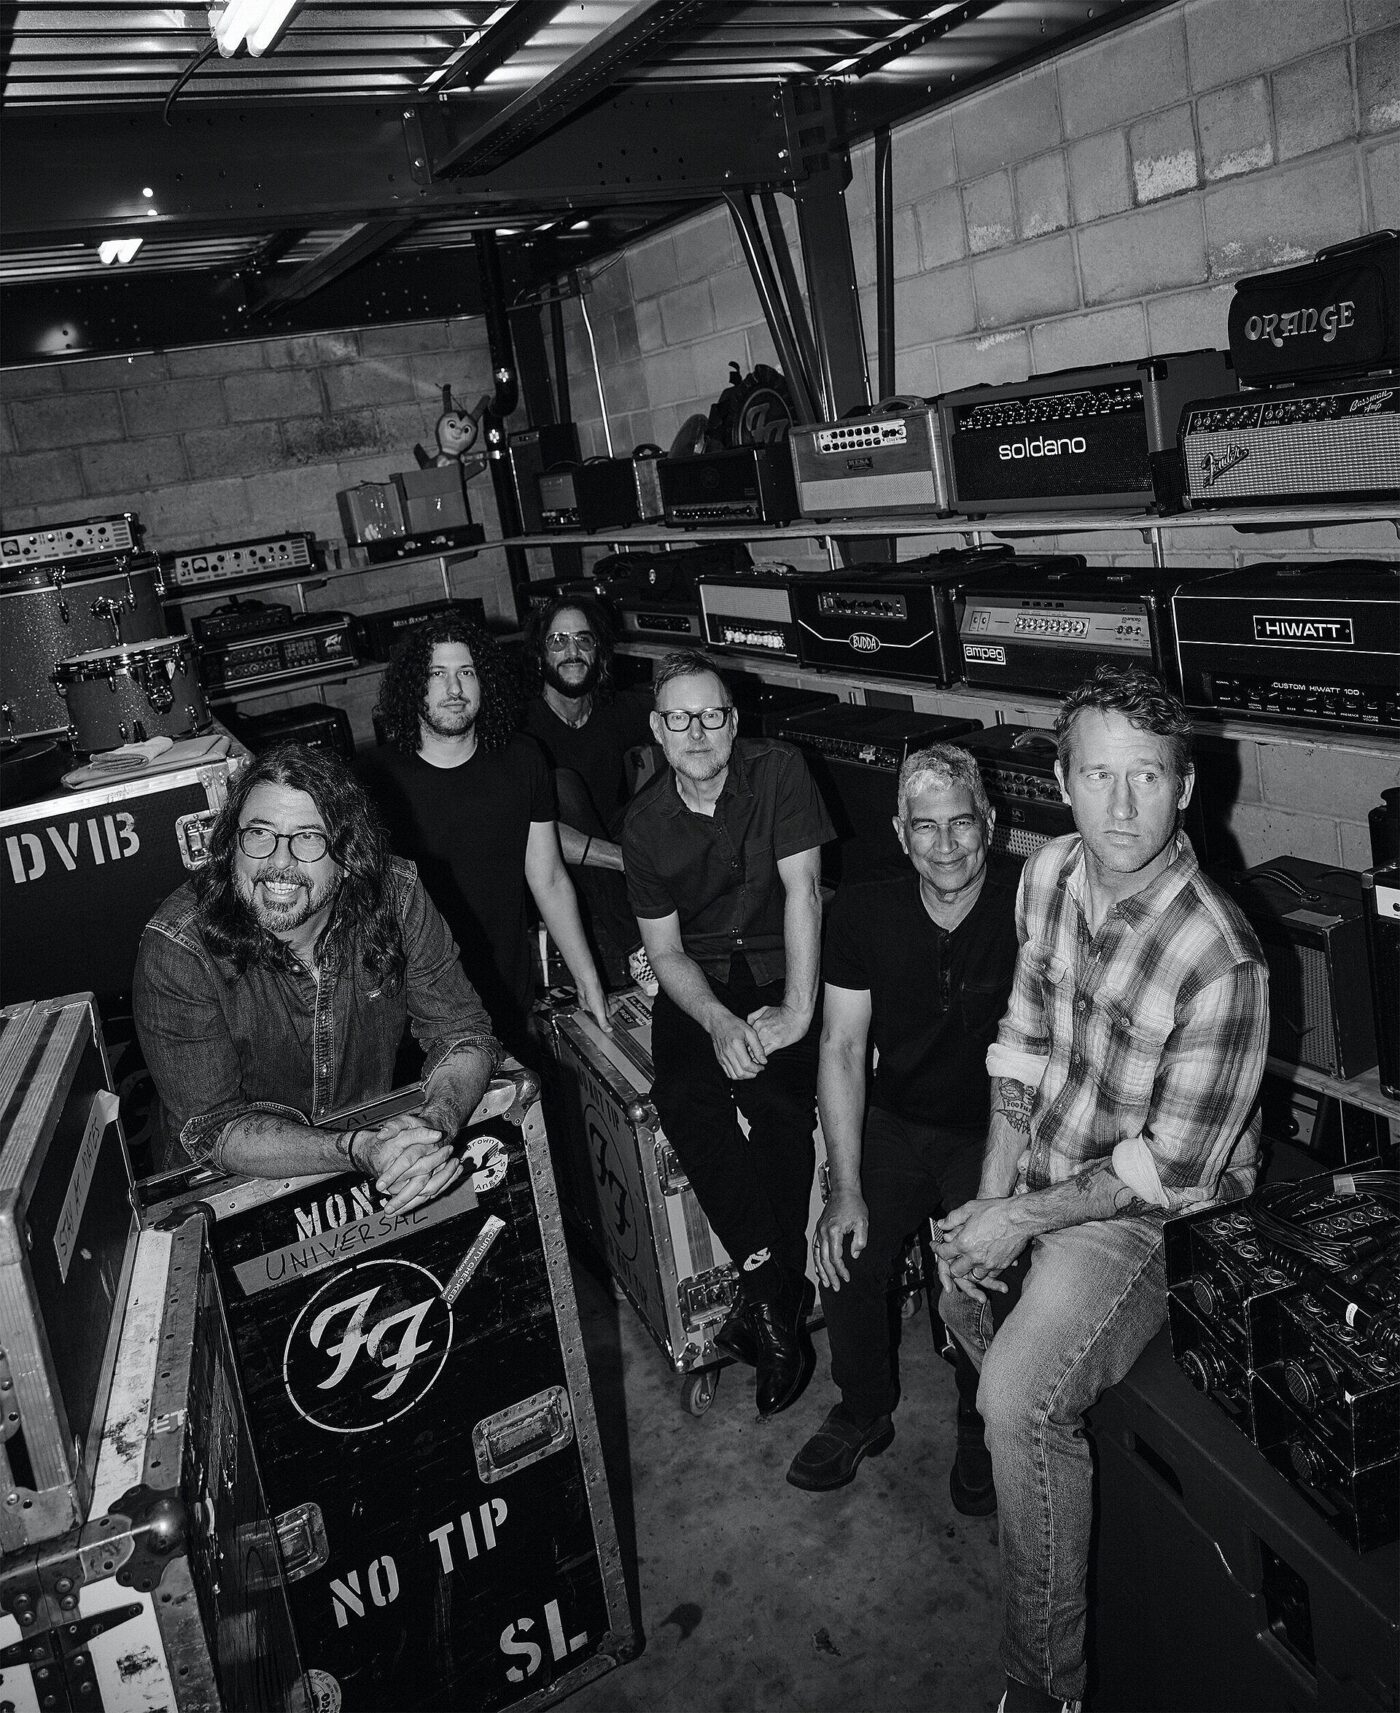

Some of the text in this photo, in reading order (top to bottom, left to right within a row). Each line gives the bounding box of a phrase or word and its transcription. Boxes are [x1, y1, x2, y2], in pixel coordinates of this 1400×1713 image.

[1245, 301, 1355, 347] ORANGE
[1350, 391, 1393, 412] Bassman
[1364, 403, 1382, 412] Amp
[999, 436, 1086, 460] soldano
[1201, 444, 1249, 488] Fender
[853, 635, 876, 650] BUDDA
[1265, 622, 1341, 638] HIWATT
[965, 646, 1004, 661] ampeg
[1273, 682, 1305, 690] CUSTOM
[1309, 685, 1341, 693] HIWATT
[5, 812, 140, 884] DVIB
[466, 1138, 496, 1152] Brown
[474, 1161, 506, 1191] Angels
[267, 1213, 428, 1281] UNIVERSAL
[447, 1262, 475, 1301] CHECKED
[329, 1497, 508, 1628] NO TIP
[499, 1598, 588, 1683] SL
